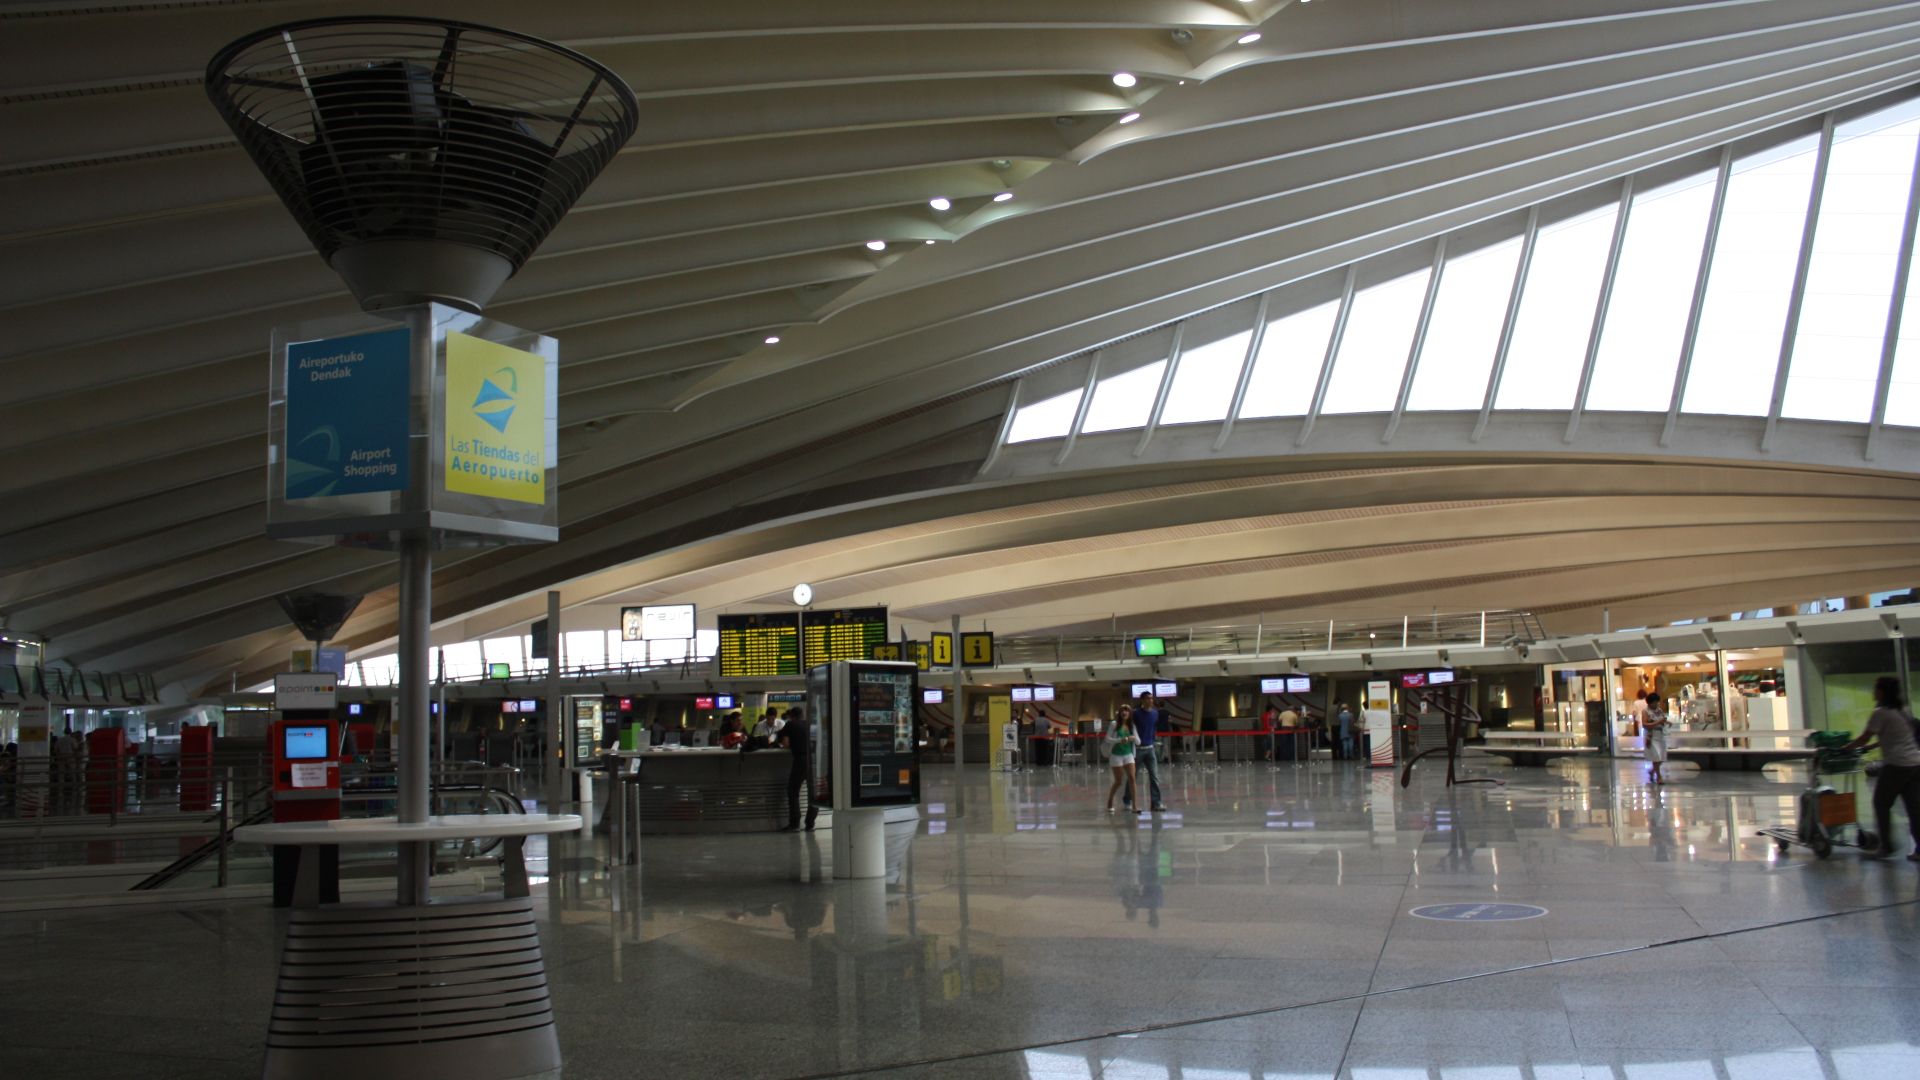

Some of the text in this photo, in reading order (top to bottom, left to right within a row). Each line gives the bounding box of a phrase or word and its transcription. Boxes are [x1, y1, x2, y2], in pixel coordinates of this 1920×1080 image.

[299, 352, 364, 369] Aireportuko
[311, 367, 352, 382] Dendak
[350, 447, 391, 462] Airport
[451, 433, 540, 467] Las Tiendas del
[344, 462, 397, 477] Shopping
[452, 456, 540, 484] Aeropuerto
